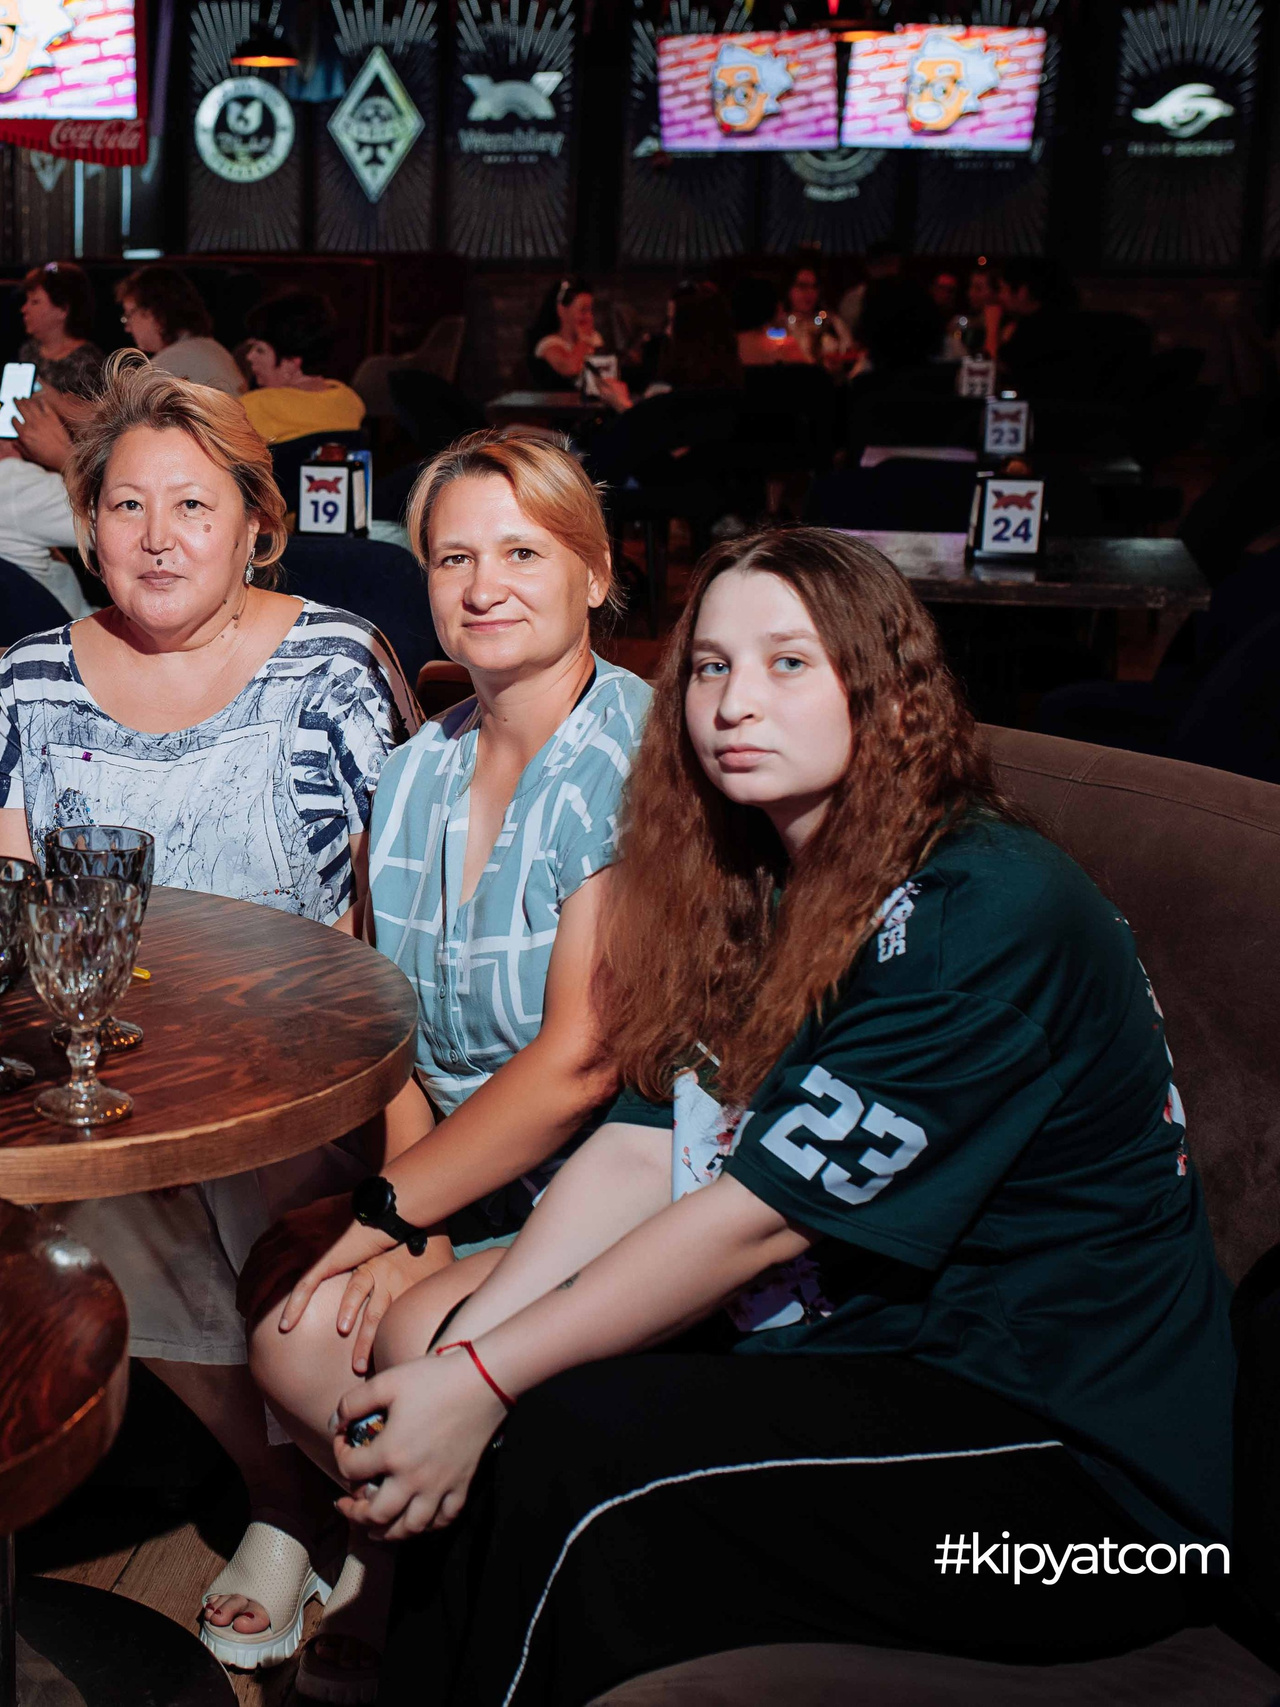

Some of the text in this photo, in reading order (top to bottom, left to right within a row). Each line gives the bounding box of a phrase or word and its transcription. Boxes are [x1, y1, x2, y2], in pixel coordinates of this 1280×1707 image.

[992, 427, 1020, 445] 23
[310, 500, 340, 524] 19
[992, 516, 1033, 543] 24
[759, 1064, 929, 1206] 23
